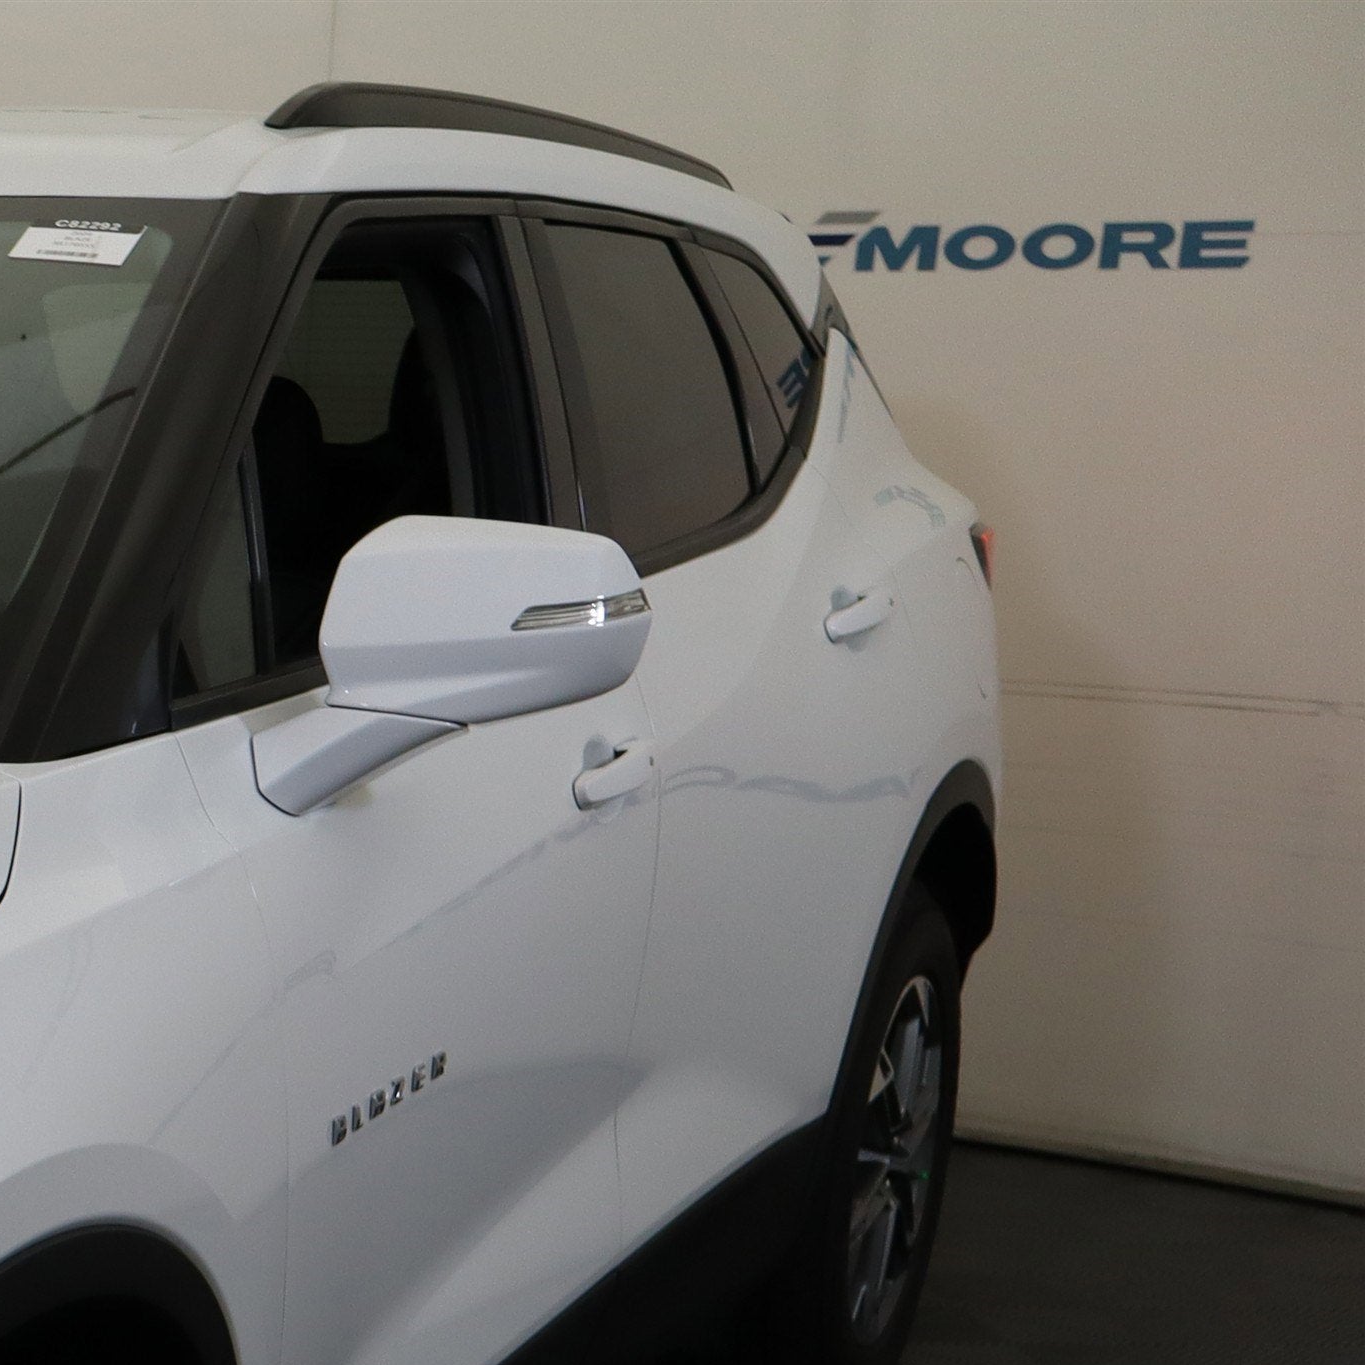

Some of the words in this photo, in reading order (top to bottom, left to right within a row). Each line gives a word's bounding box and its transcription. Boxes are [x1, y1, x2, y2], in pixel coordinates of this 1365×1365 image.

[54, 219, 122, 232] C82292
[854, 220, 1255, 272] MOORE
[332, 1051, 448, 1147] BLAZER
